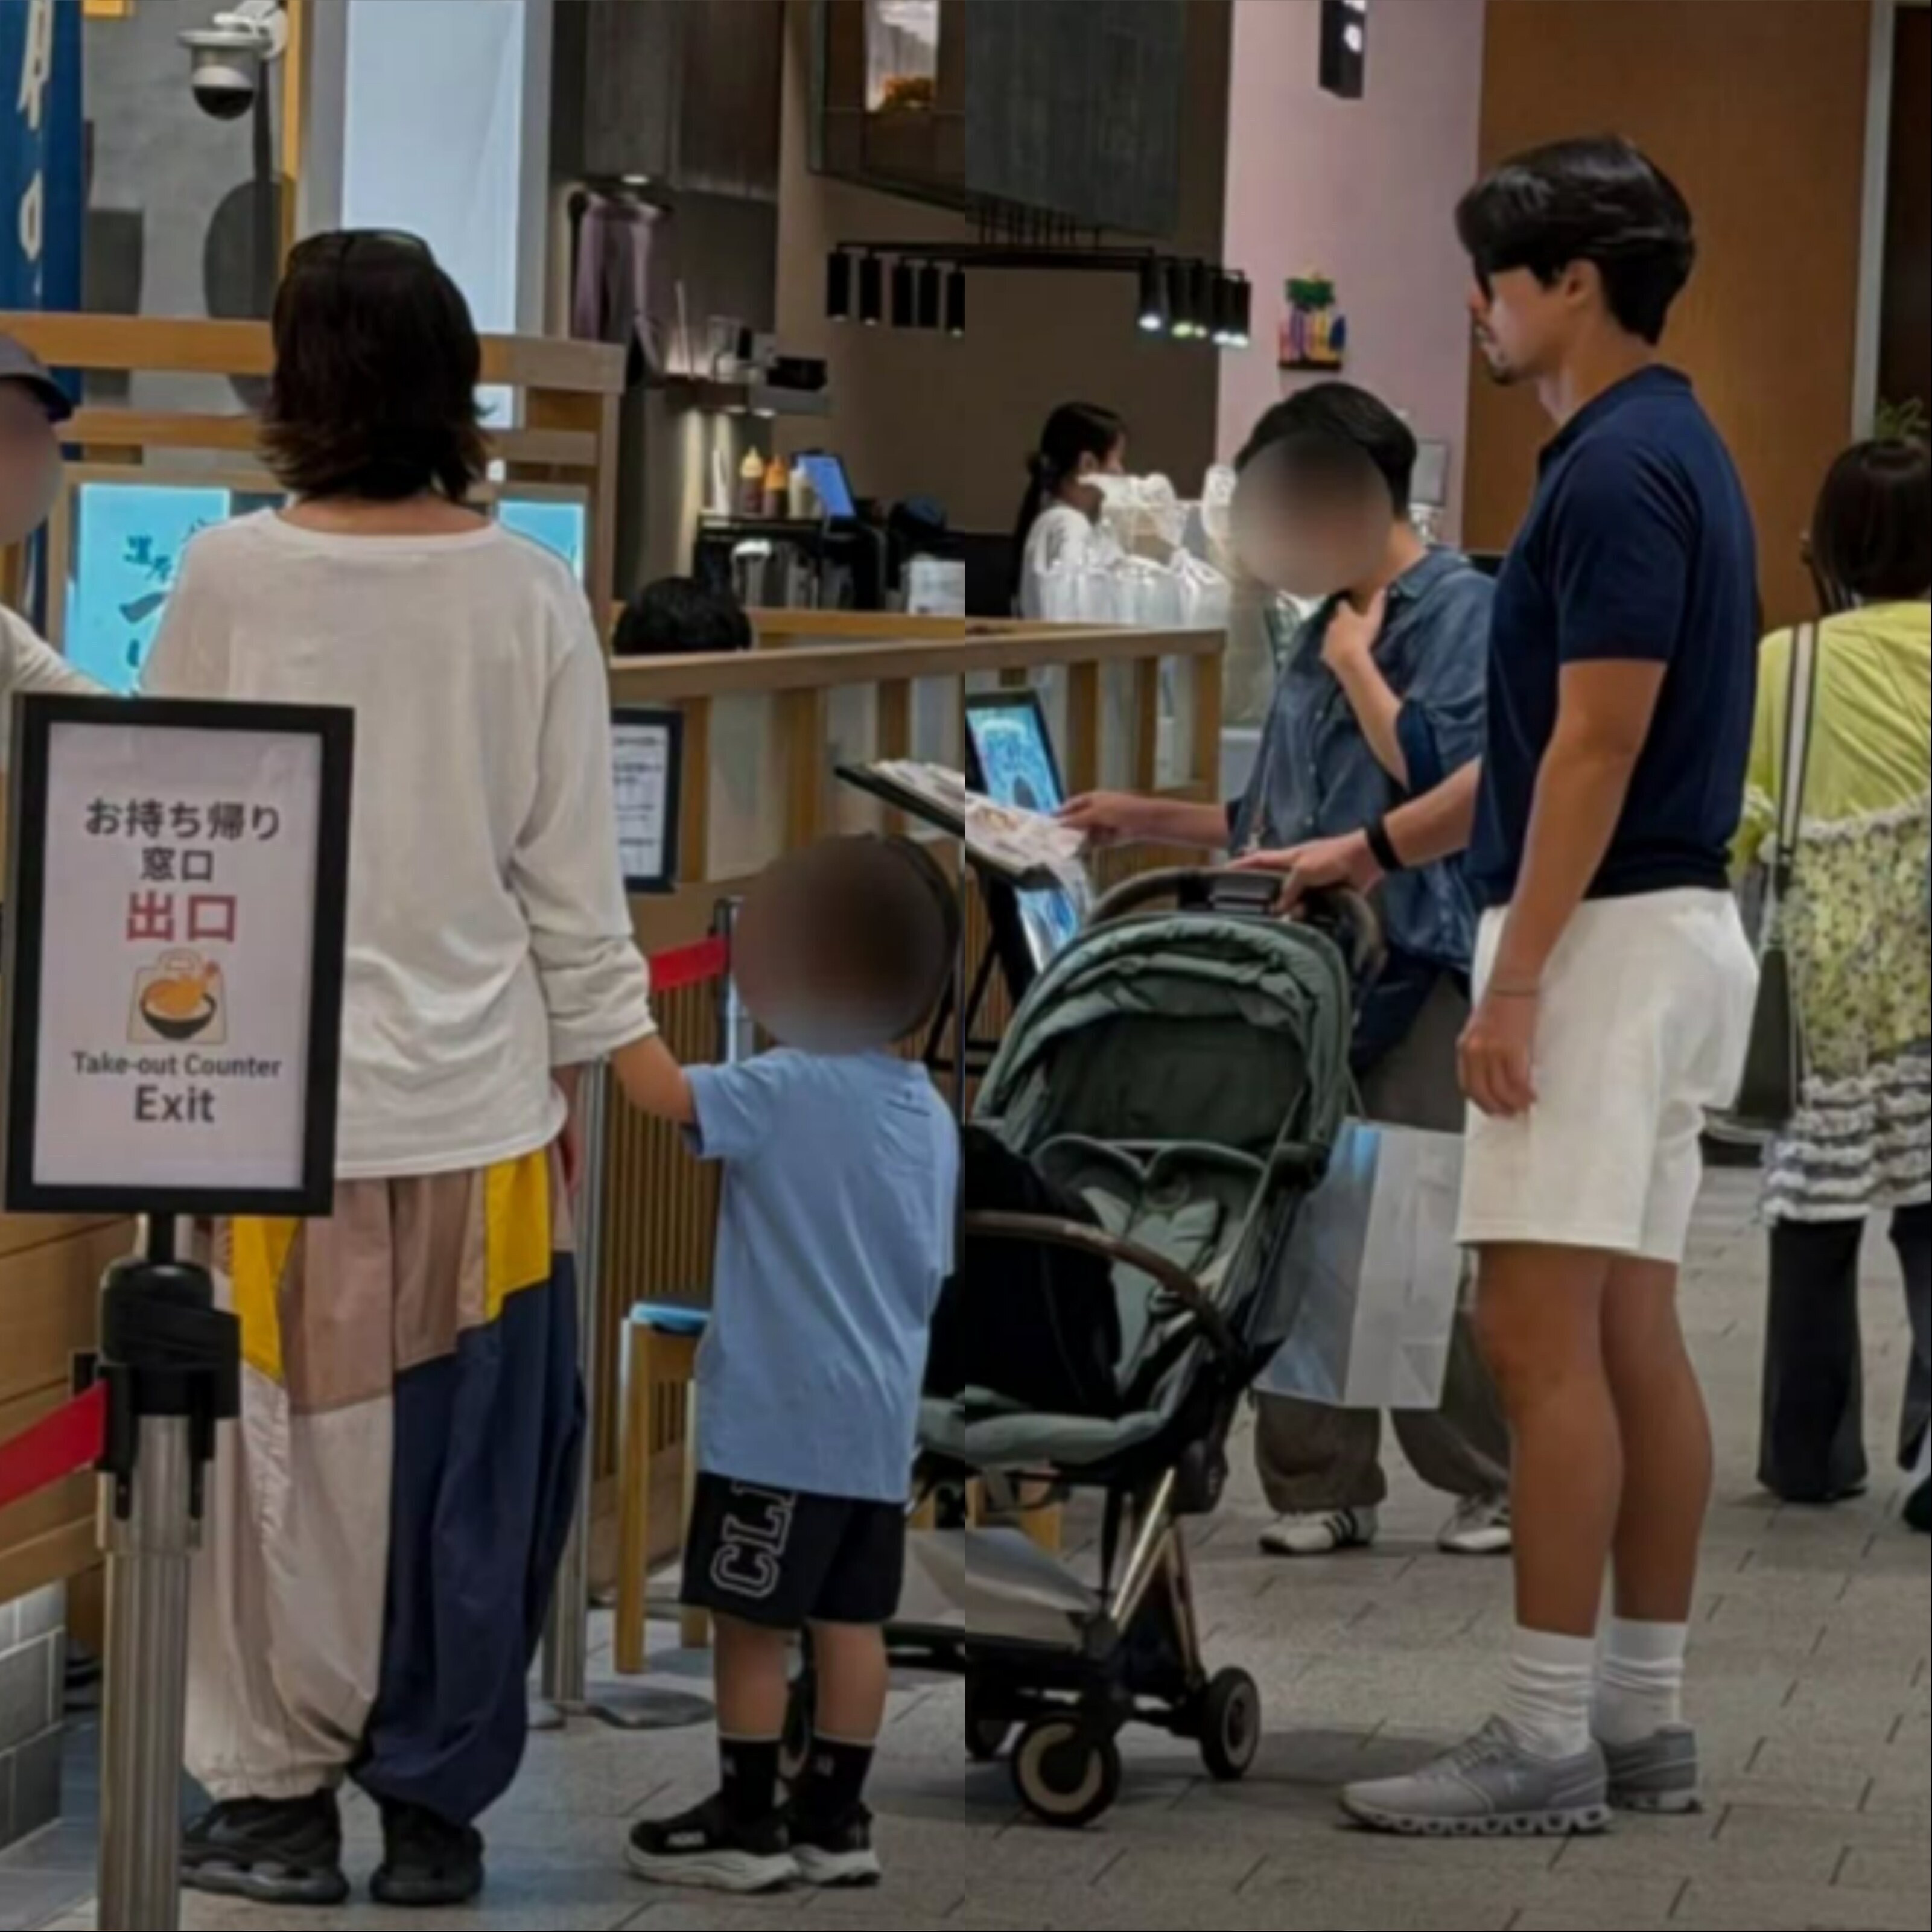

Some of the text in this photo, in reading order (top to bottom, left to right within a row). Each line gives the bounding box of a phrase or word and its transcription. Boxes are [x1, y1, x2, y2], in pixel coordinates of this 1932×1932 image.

[86, 797, 280, 841] お持ち帰り
[141, 846, 214, 882] 窓口
[126, 889, 237, 943] 出口
[72, 1050, 282, 1078] Take-out Counter
[135, 1084, 215, 1122] Exit
